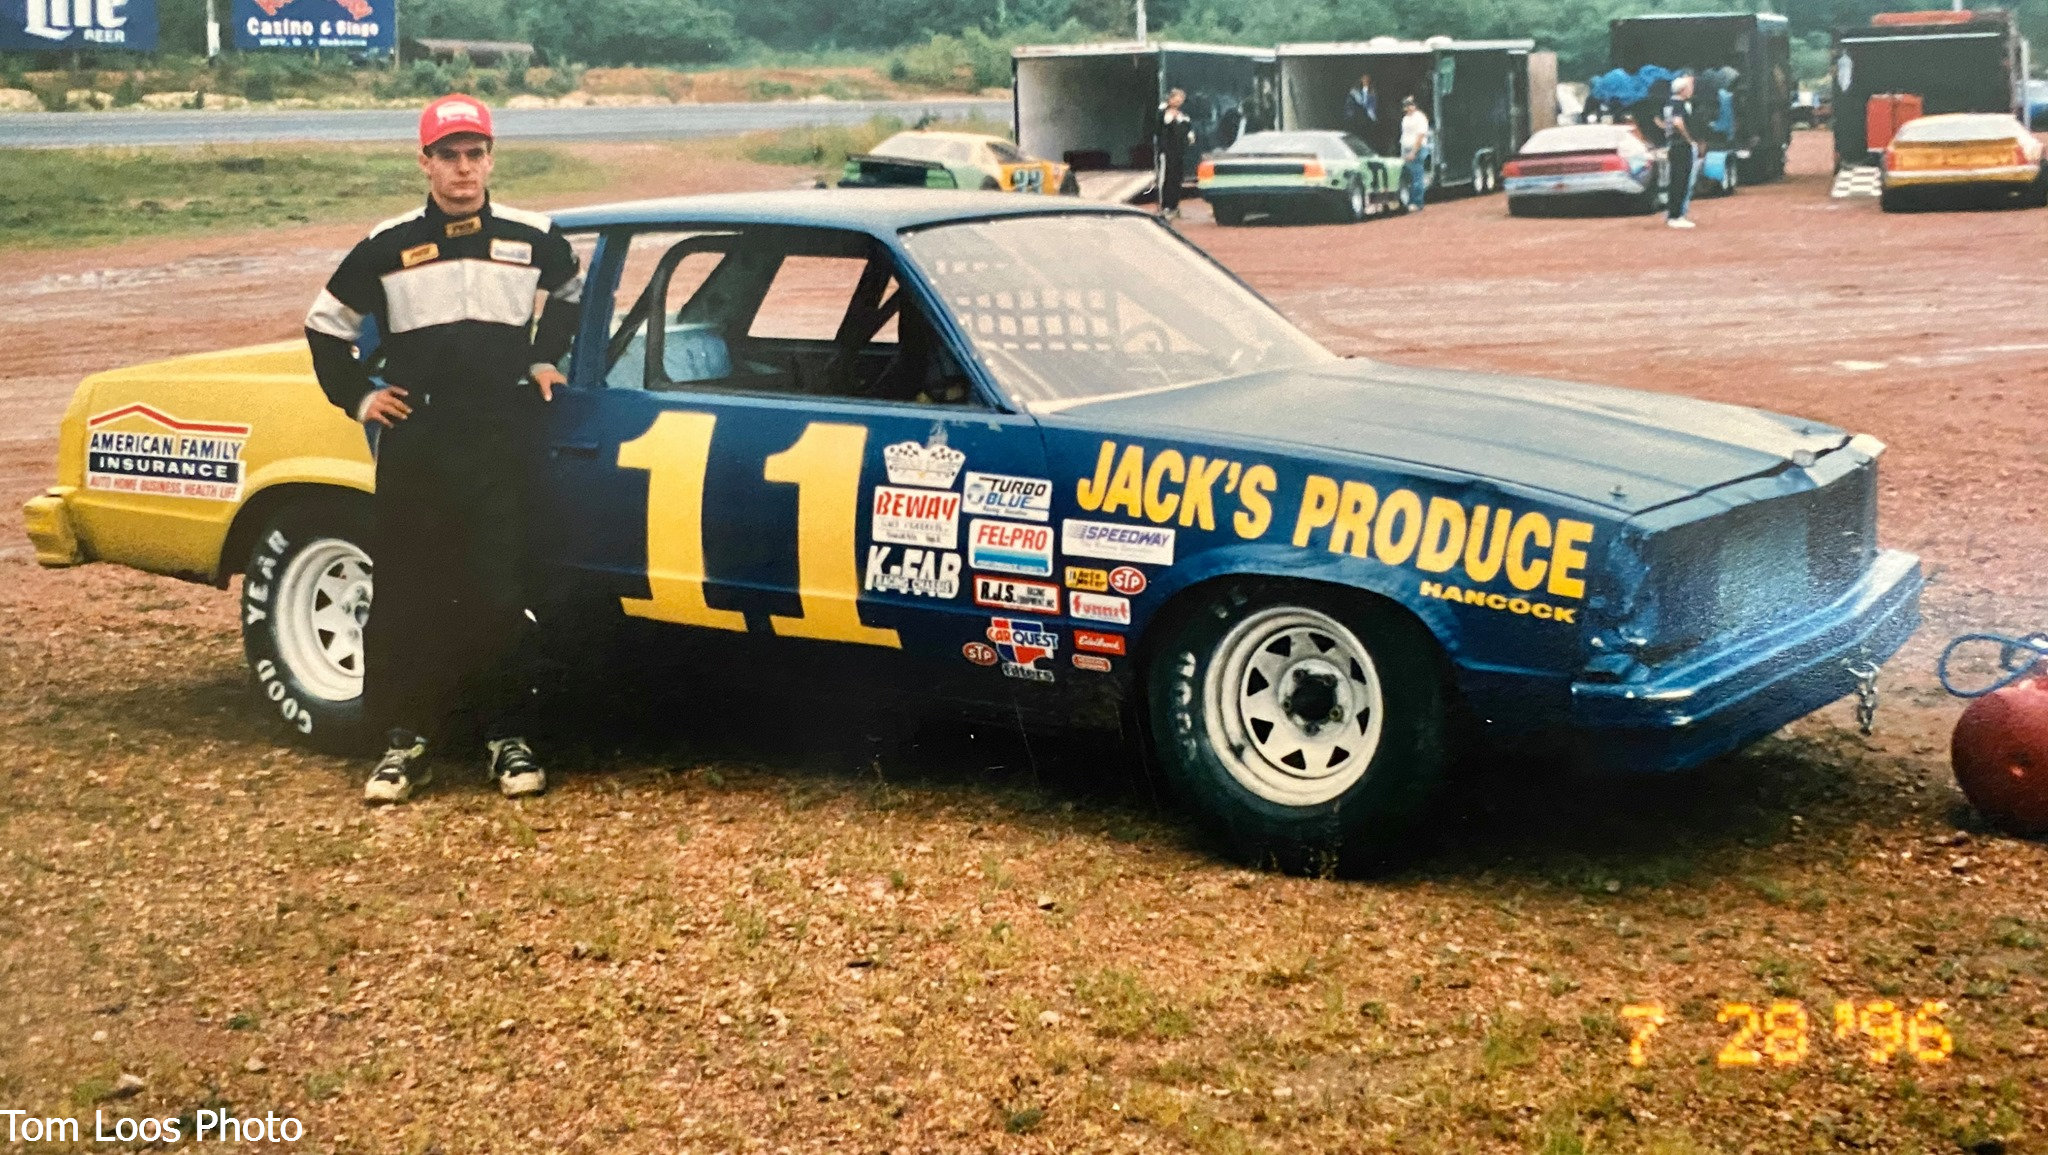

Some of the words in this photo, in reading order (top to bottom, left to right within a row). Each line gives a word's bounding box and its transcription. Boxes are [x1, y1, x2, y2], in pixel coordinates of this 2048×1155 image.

[247, 16, 314, 36] Casino
[90, 433, 174, 455] AMERICAN
[180, 438, 242, 460] FAMILY
[99, 456, 228, 479] INSURANCE
[980, 476, 1047, 497] TURBO
[876, 491, 959, 521] BEWAY
[985, 492, 1036, 509] BLUE
[617, 410, 903, 649] 11
[1076, 440, 1278, 539] JACK'S
[1292, 475, 1595, 599] PRODUCE
[976, 523, 1048, 551] FEL-PRO
[1087, 526, 1170, 547] SPEEDWAY
[247, 530, 290, 625] YEAR
[864, 545, 963, 600] K-FAB
[1115, 571, 1138, 589] STP
[1419, 580, 1577, 624] HANCOCK
[967, 645, 992, 661] STP
[256, 659, 313, 734] GOOD
